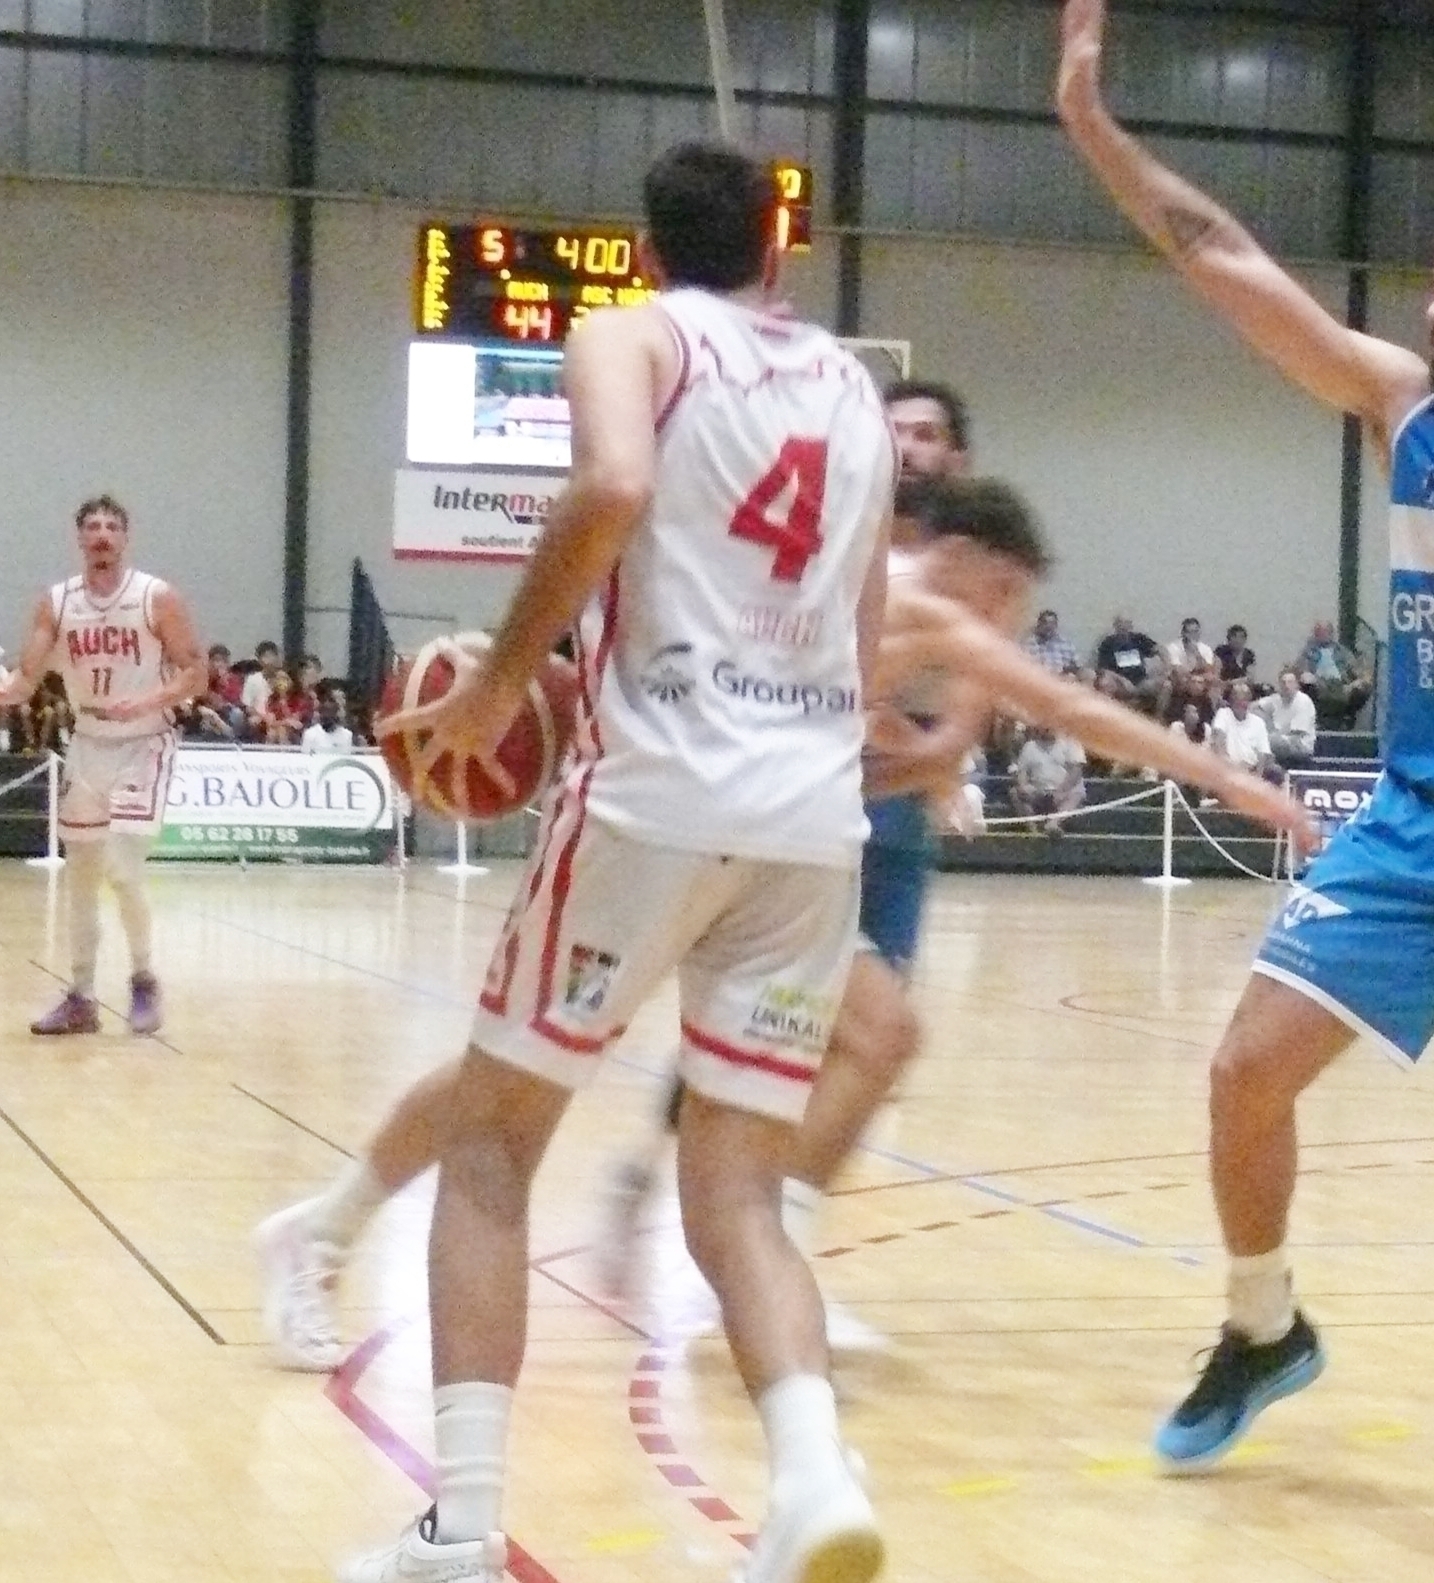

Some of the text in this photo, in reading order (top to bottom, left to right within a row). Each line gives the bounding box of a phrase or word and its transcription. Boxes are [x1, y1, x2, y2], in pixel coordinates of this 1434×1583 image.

[504, 304, 552, 338] 44
[728, 437, 829, 584] 4
[66, 625, 141, 666] AUCH
[92, 667, 112, 696] 11
[207, 826, 230, 842] 62
